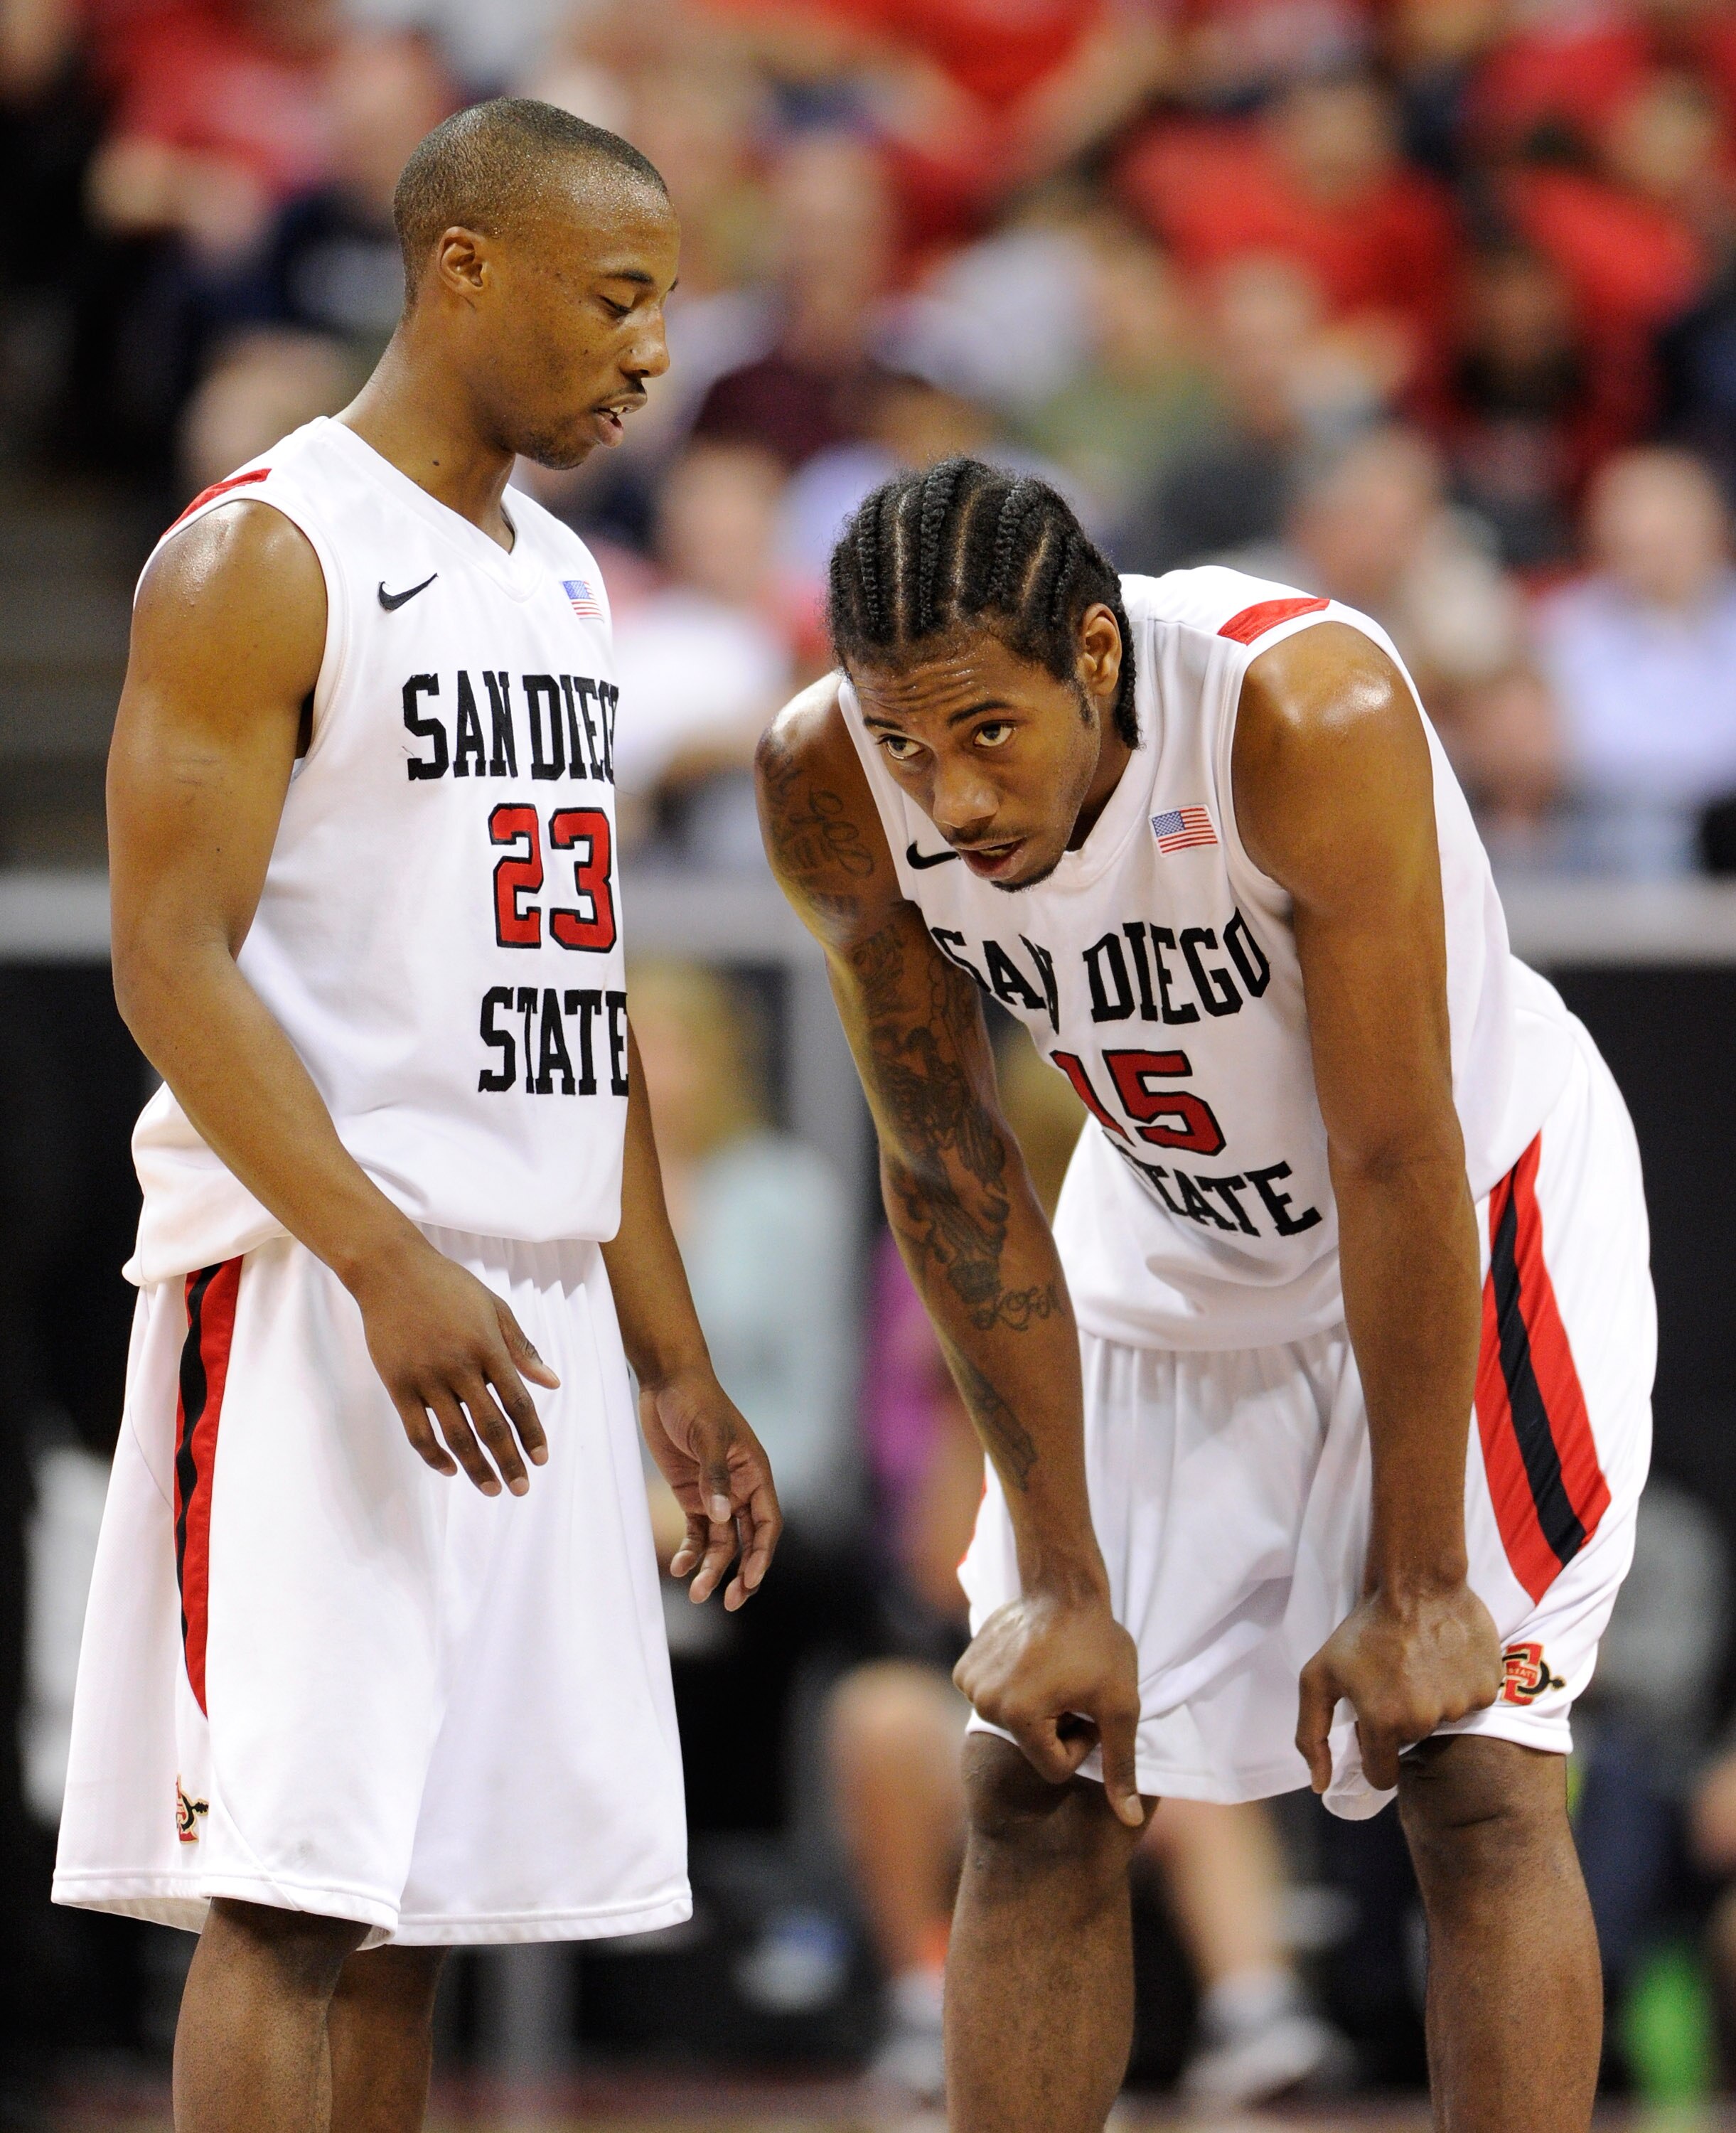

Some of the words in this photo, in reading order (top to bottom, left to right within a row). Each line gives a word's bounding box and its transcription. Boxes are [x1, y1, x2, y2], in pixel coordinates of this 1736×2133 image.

[403, 670, 518, 781] SAN
[488, 803, 617, 953] 23
[1083, 907, 1270, 1025] DIEGO
[478, 986, 629, 1097] STATE
